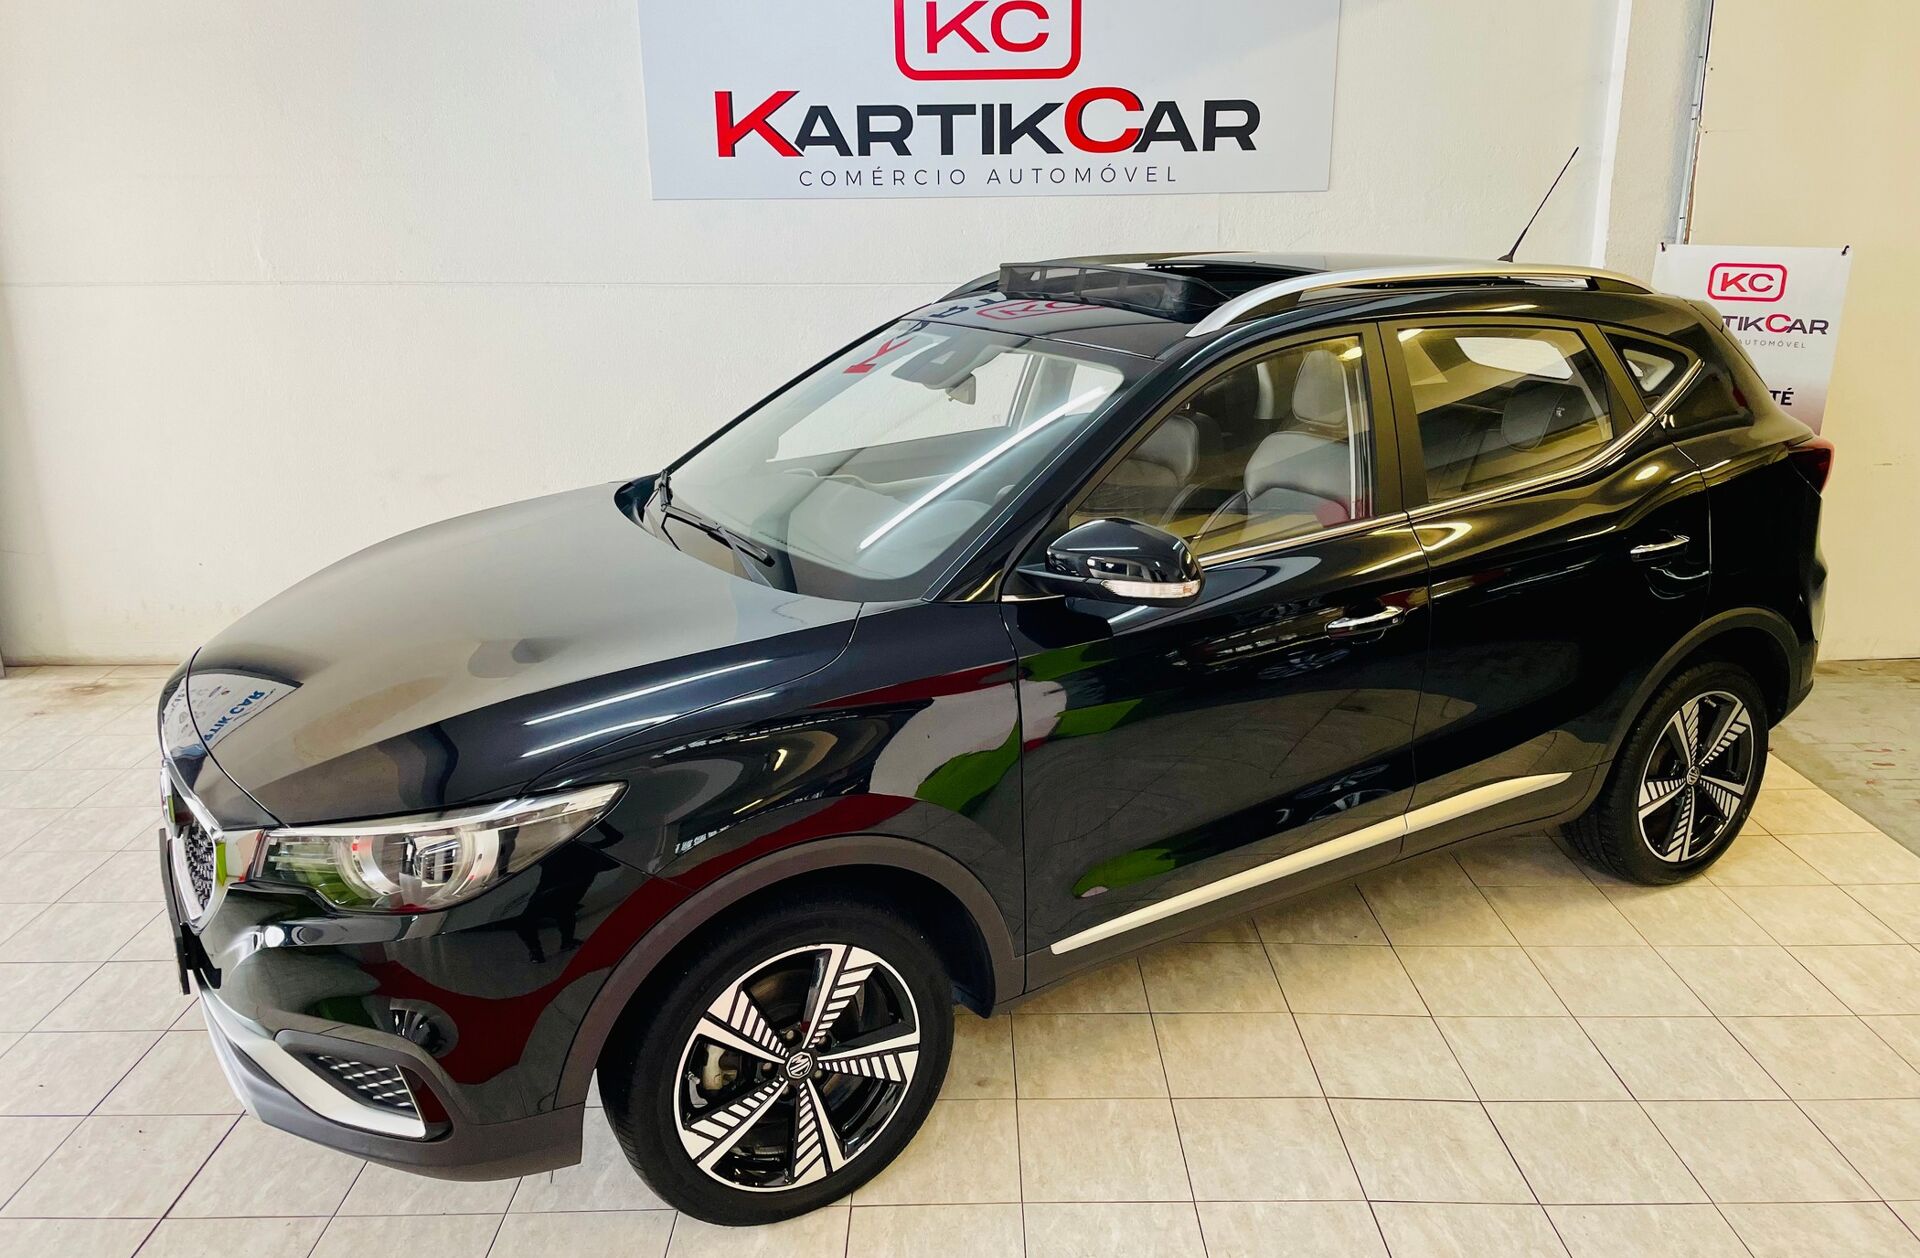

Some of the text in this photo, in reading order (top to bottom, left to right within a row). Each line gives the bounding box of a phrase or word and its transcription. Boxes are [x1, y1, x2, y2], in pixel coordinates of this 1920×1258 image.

[926, 0, 1050, 53] KC
[799, 163, 1177, 187] COMÉRCIO AUTOMÓVEL
[1720, 272, 1774, 292] KC
[1721, 313, 1829, 335] TIKCAR
[1769, 387, 1794, 406] TÉ
